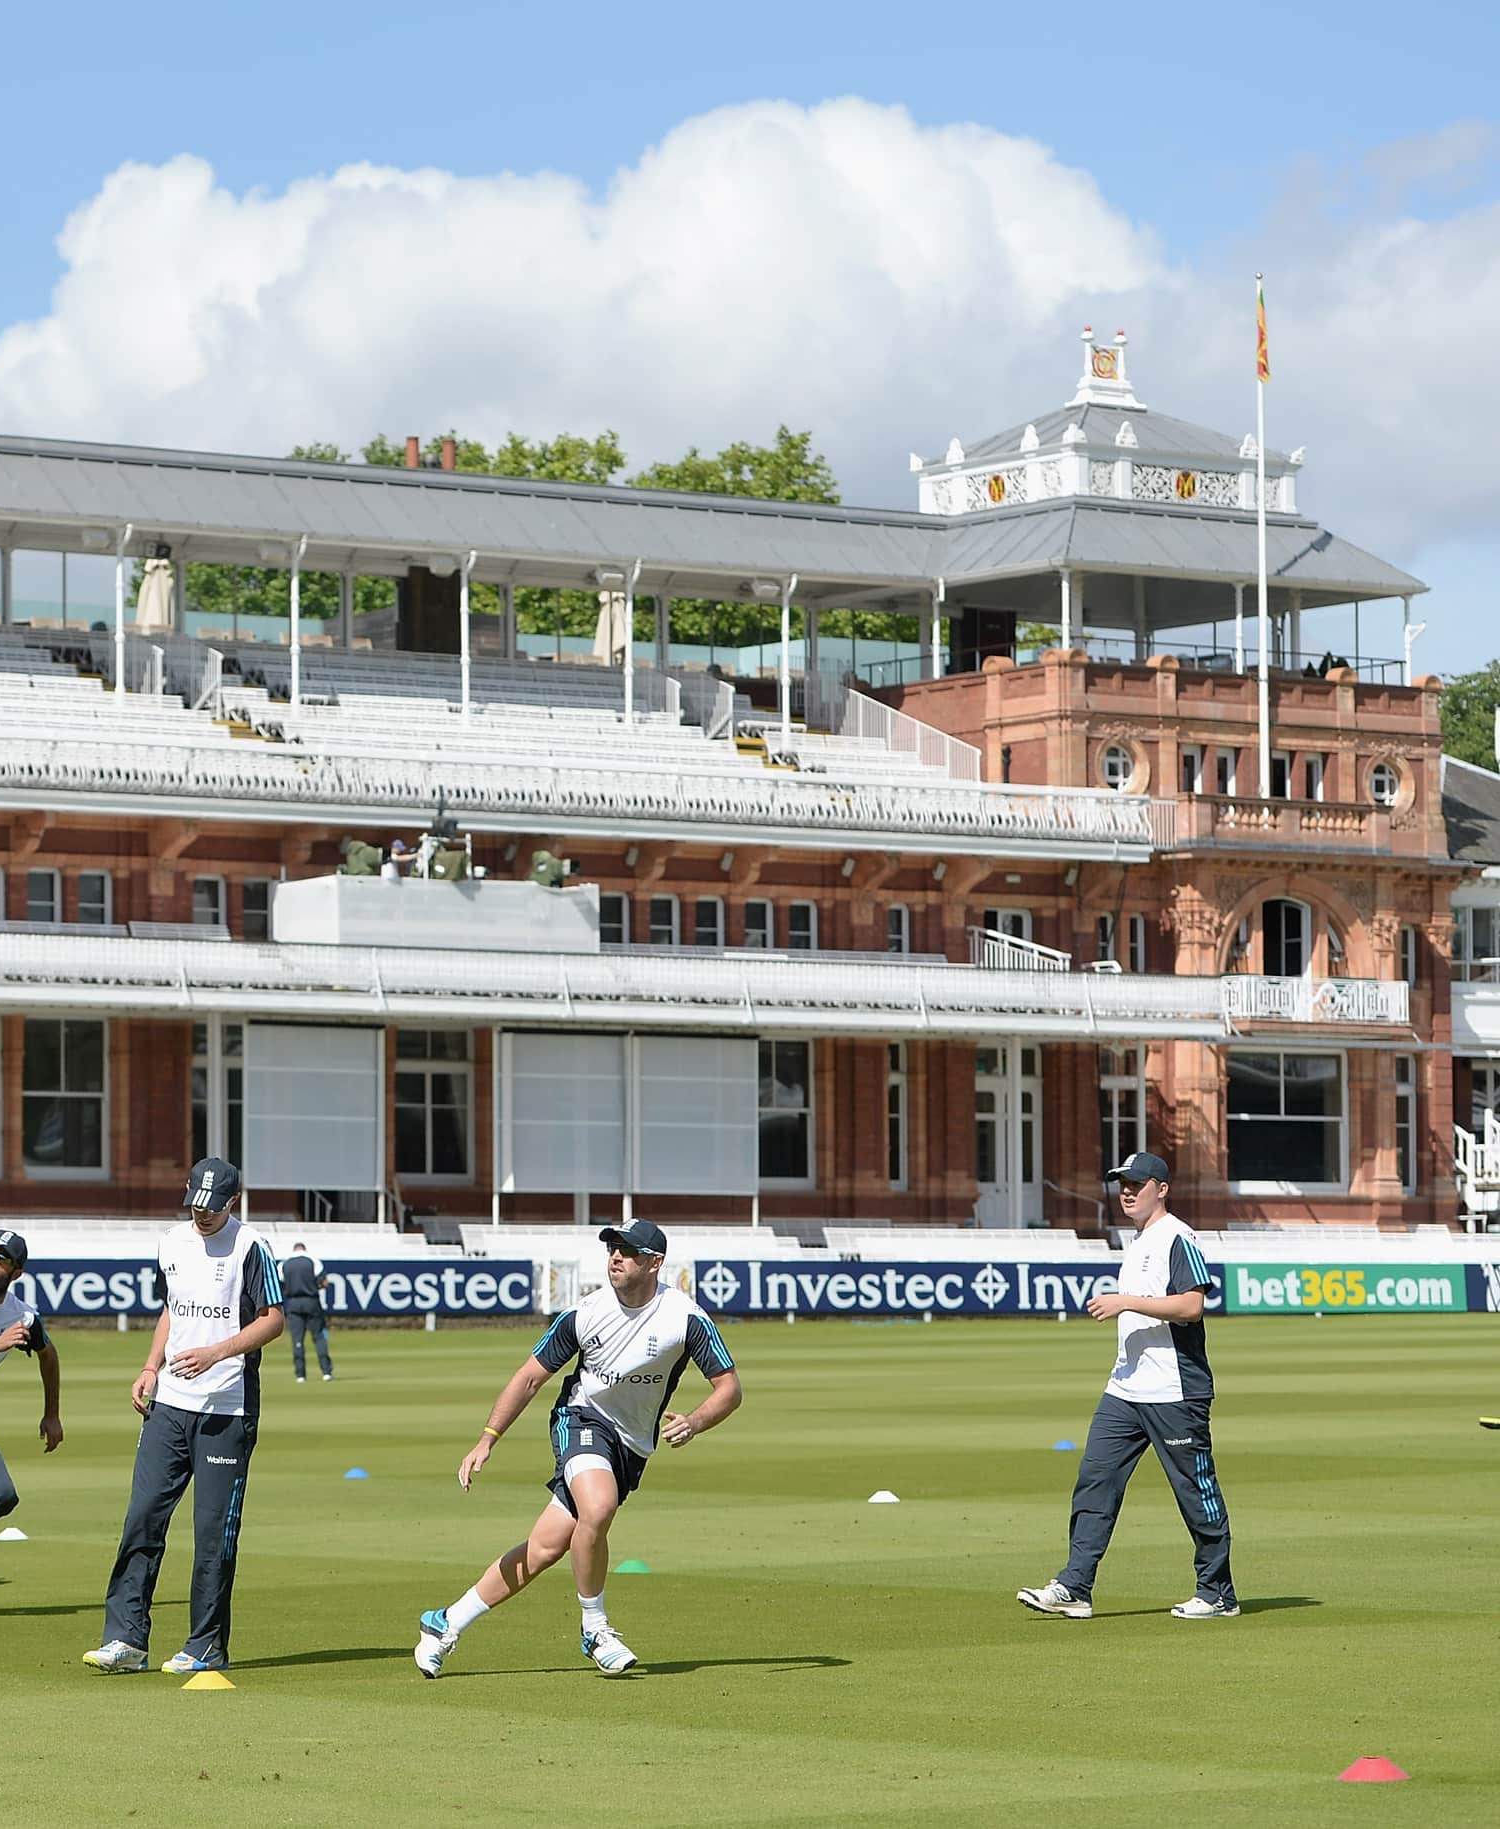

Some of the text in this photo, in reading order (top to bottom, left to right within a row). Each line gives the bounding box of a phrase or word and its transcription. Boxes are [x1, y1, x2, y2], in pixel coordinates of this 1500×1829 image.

[320, 1268, 530, 1310] nvestec
[748, 1262, 964, 1310] Investec
[1237, 1267, 1453, 1307] bet365.com
